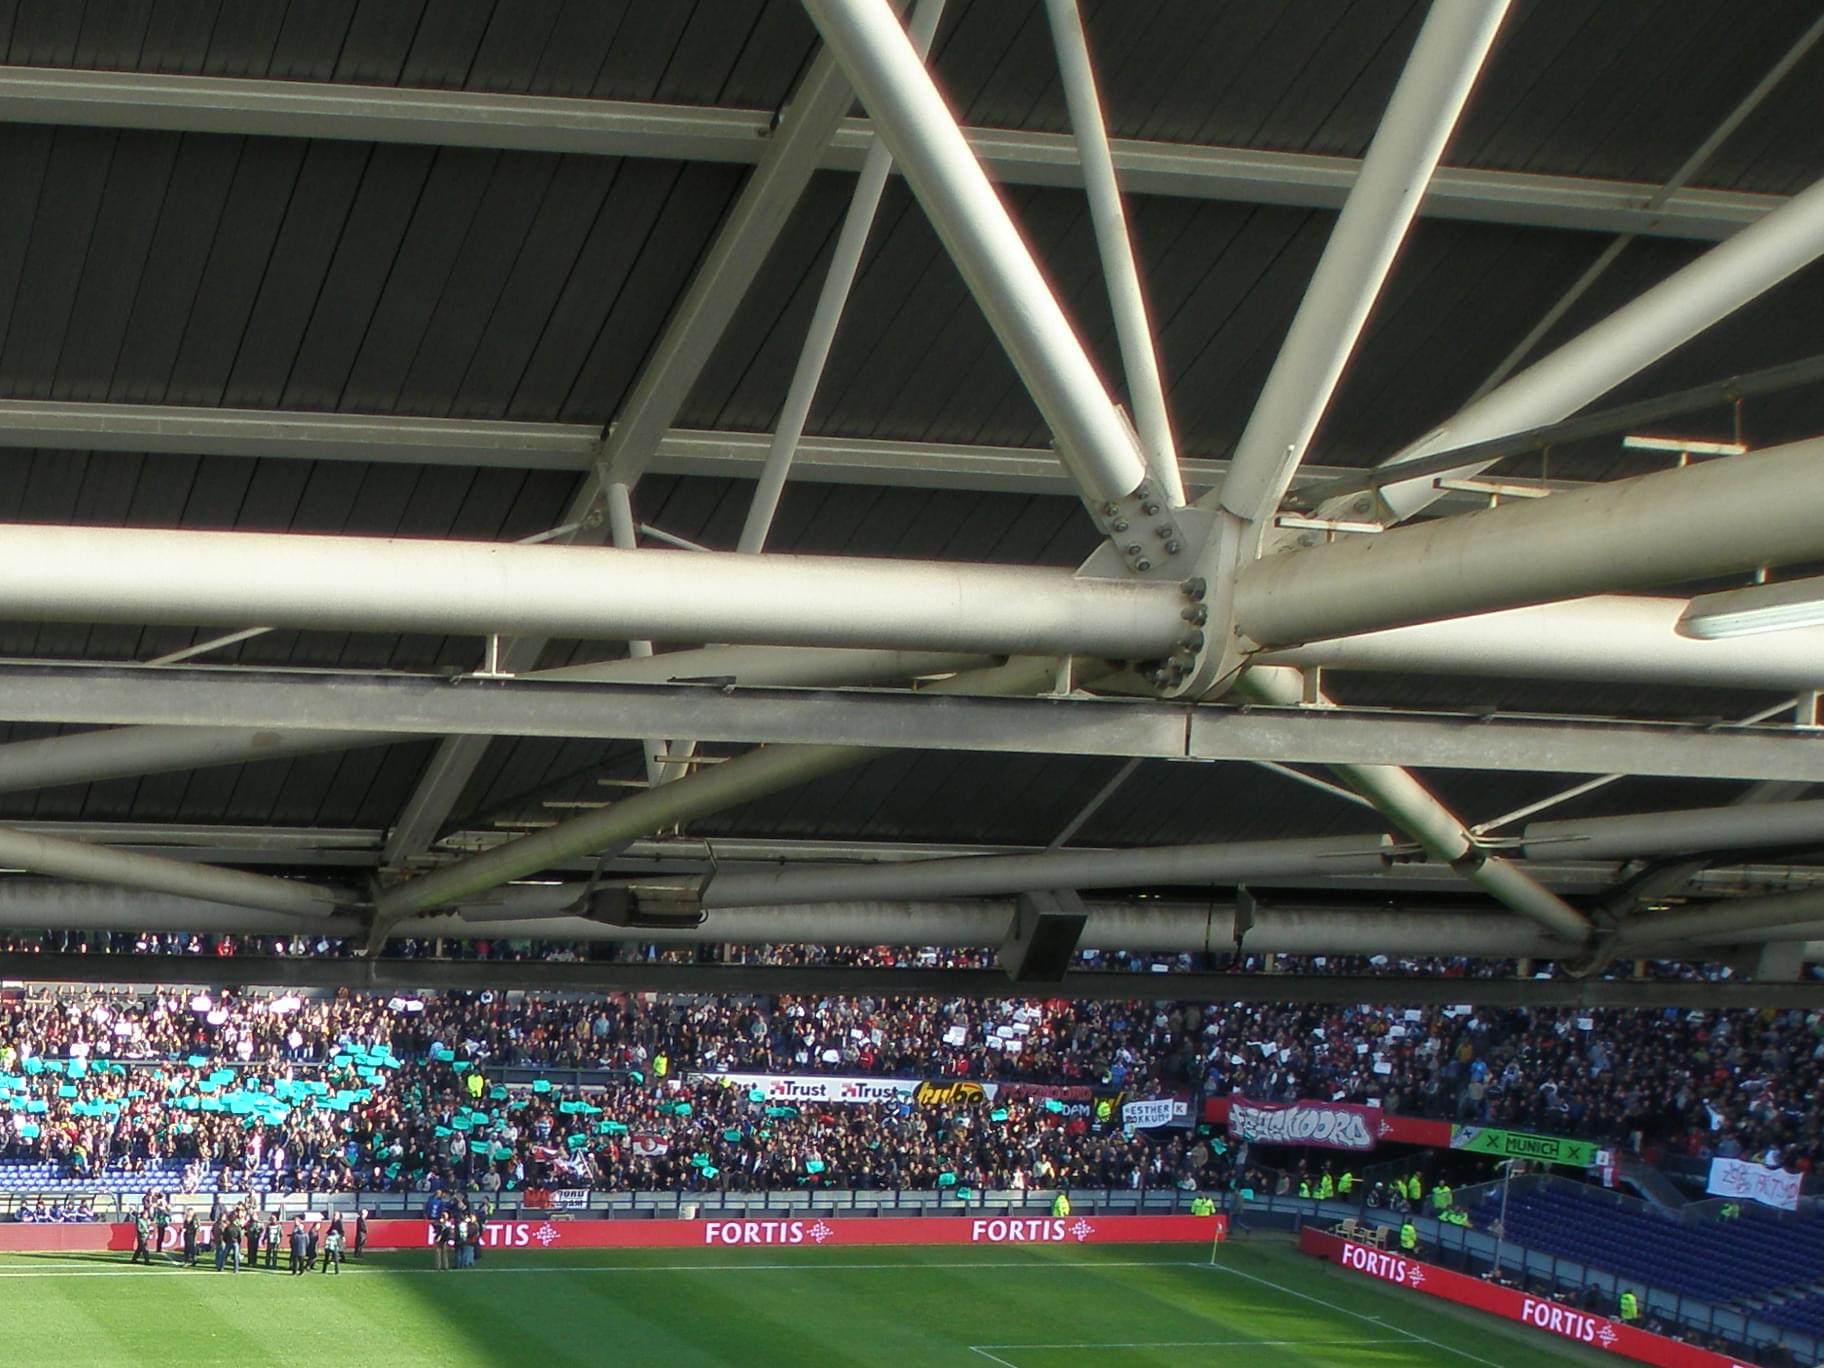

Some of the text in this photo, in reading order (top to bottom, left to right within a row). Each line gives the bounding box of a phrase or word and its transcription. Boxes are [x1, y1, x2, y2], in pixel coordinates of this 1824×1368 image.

[783, 1081, 826, 1097] Trust
[855, 1082, 899, 1099] Trust
[1131, 1103, 1170, 1115] ESTHER
[1506, 1136, 1559, 1158] MUNICH
[705, 1222, 804, 1244] FORTIS
[972, 1219, 1066, 1241] FORTIS
[1342, 1243, 1406, 1283] FORTIS
[1522, 1299, 1596, 1342] FORTIS
